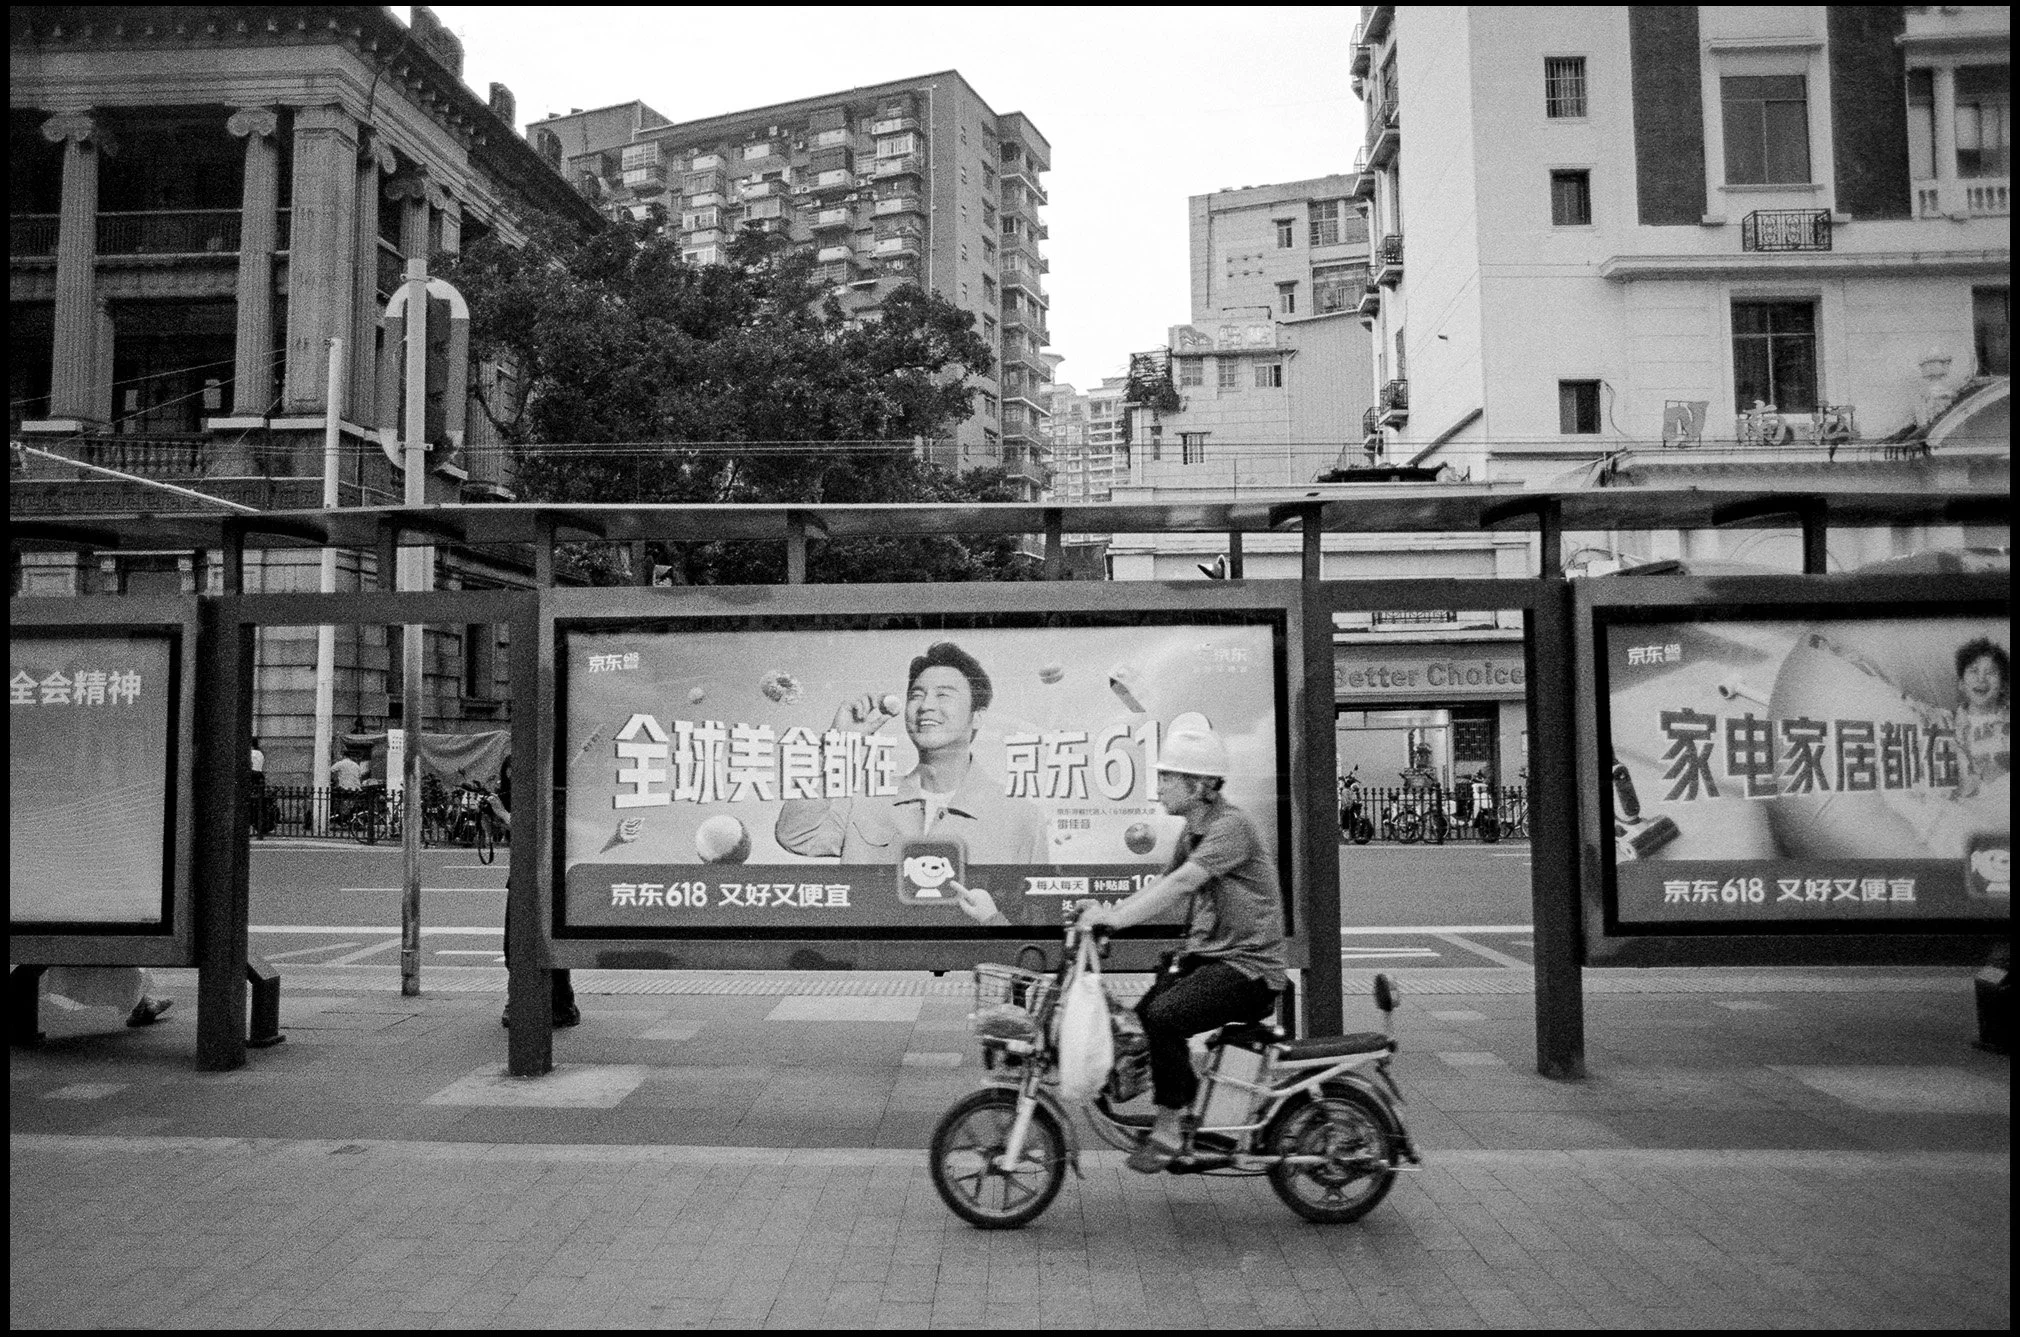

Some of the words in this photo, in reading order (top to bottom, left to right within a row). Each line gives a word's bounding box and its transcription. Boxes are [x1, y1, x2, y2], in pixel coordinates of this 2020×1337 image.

[10, 669, 142, 705] 全会精神
[1334, 665, 1419, 688] Better
[1427, 661, 1524, 687] Choice
[612, 713, 898, 809] 全球美食都在
[1004, 711, 1213, 801] 京东61
[1660, 708, 1960, 801] 家电家居都在
[611, 882, 708, 908] 京东618
[718, 883, 851, 908] 又好又便宜
[1663, 878, 1765, 904] 京东618
[1776, 878, 1917, 903] 又好又便宜
